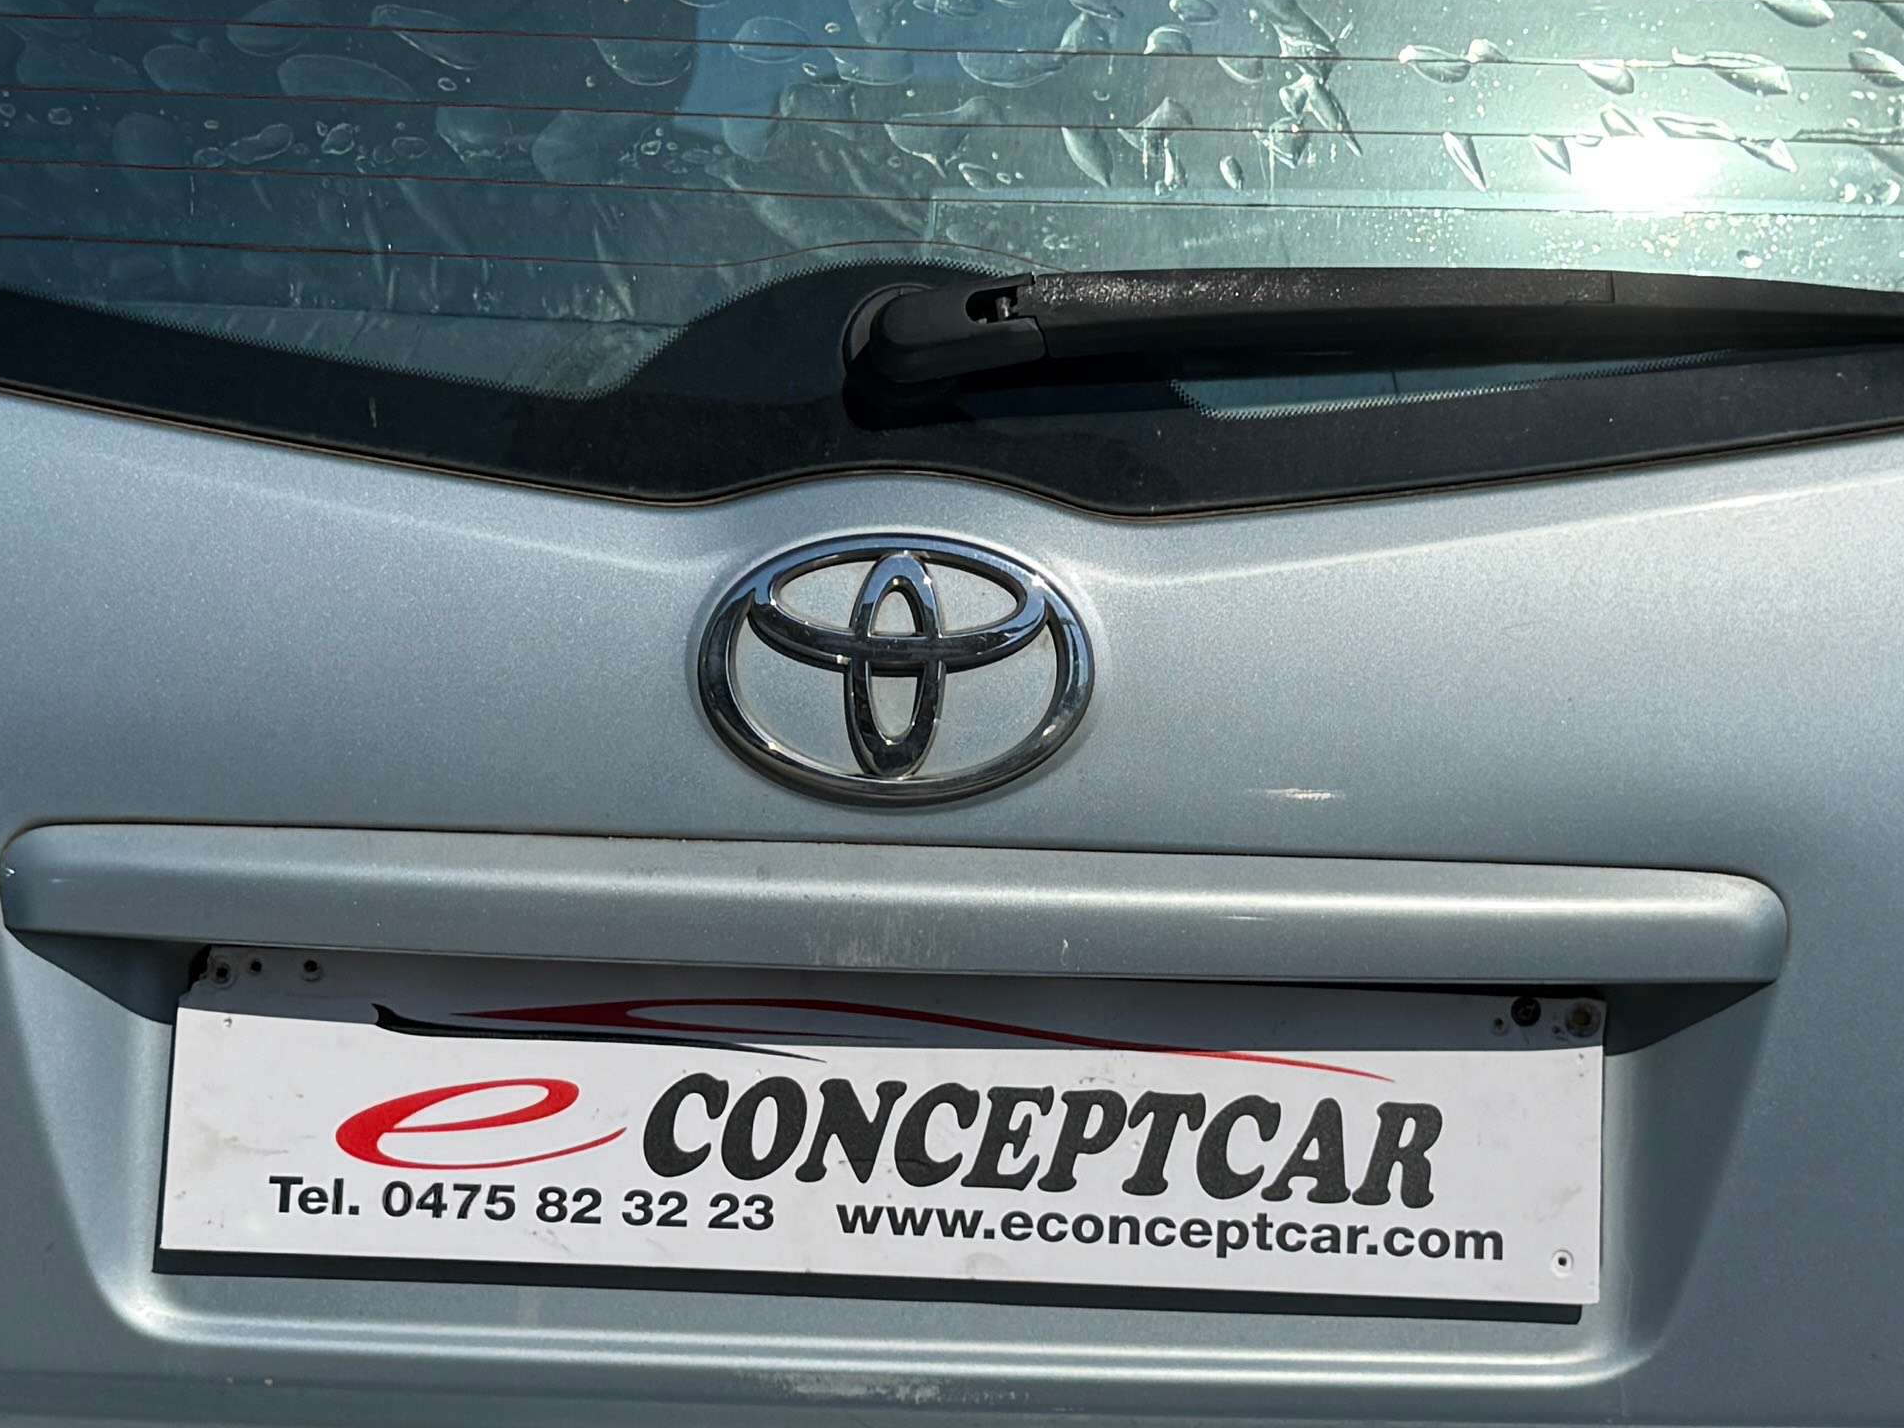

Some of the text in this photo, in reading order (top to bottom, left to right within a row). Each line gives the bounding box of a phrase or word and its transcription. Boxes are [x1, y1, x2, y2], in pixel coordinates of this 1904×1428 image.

[642, 1072, 1443, 1209] CONCEPTCAR
[268, 1175, 774, 1231] Tel. 0475 82 32 23
[835, 1203, 1504, 1261] www.econceptcar.com
